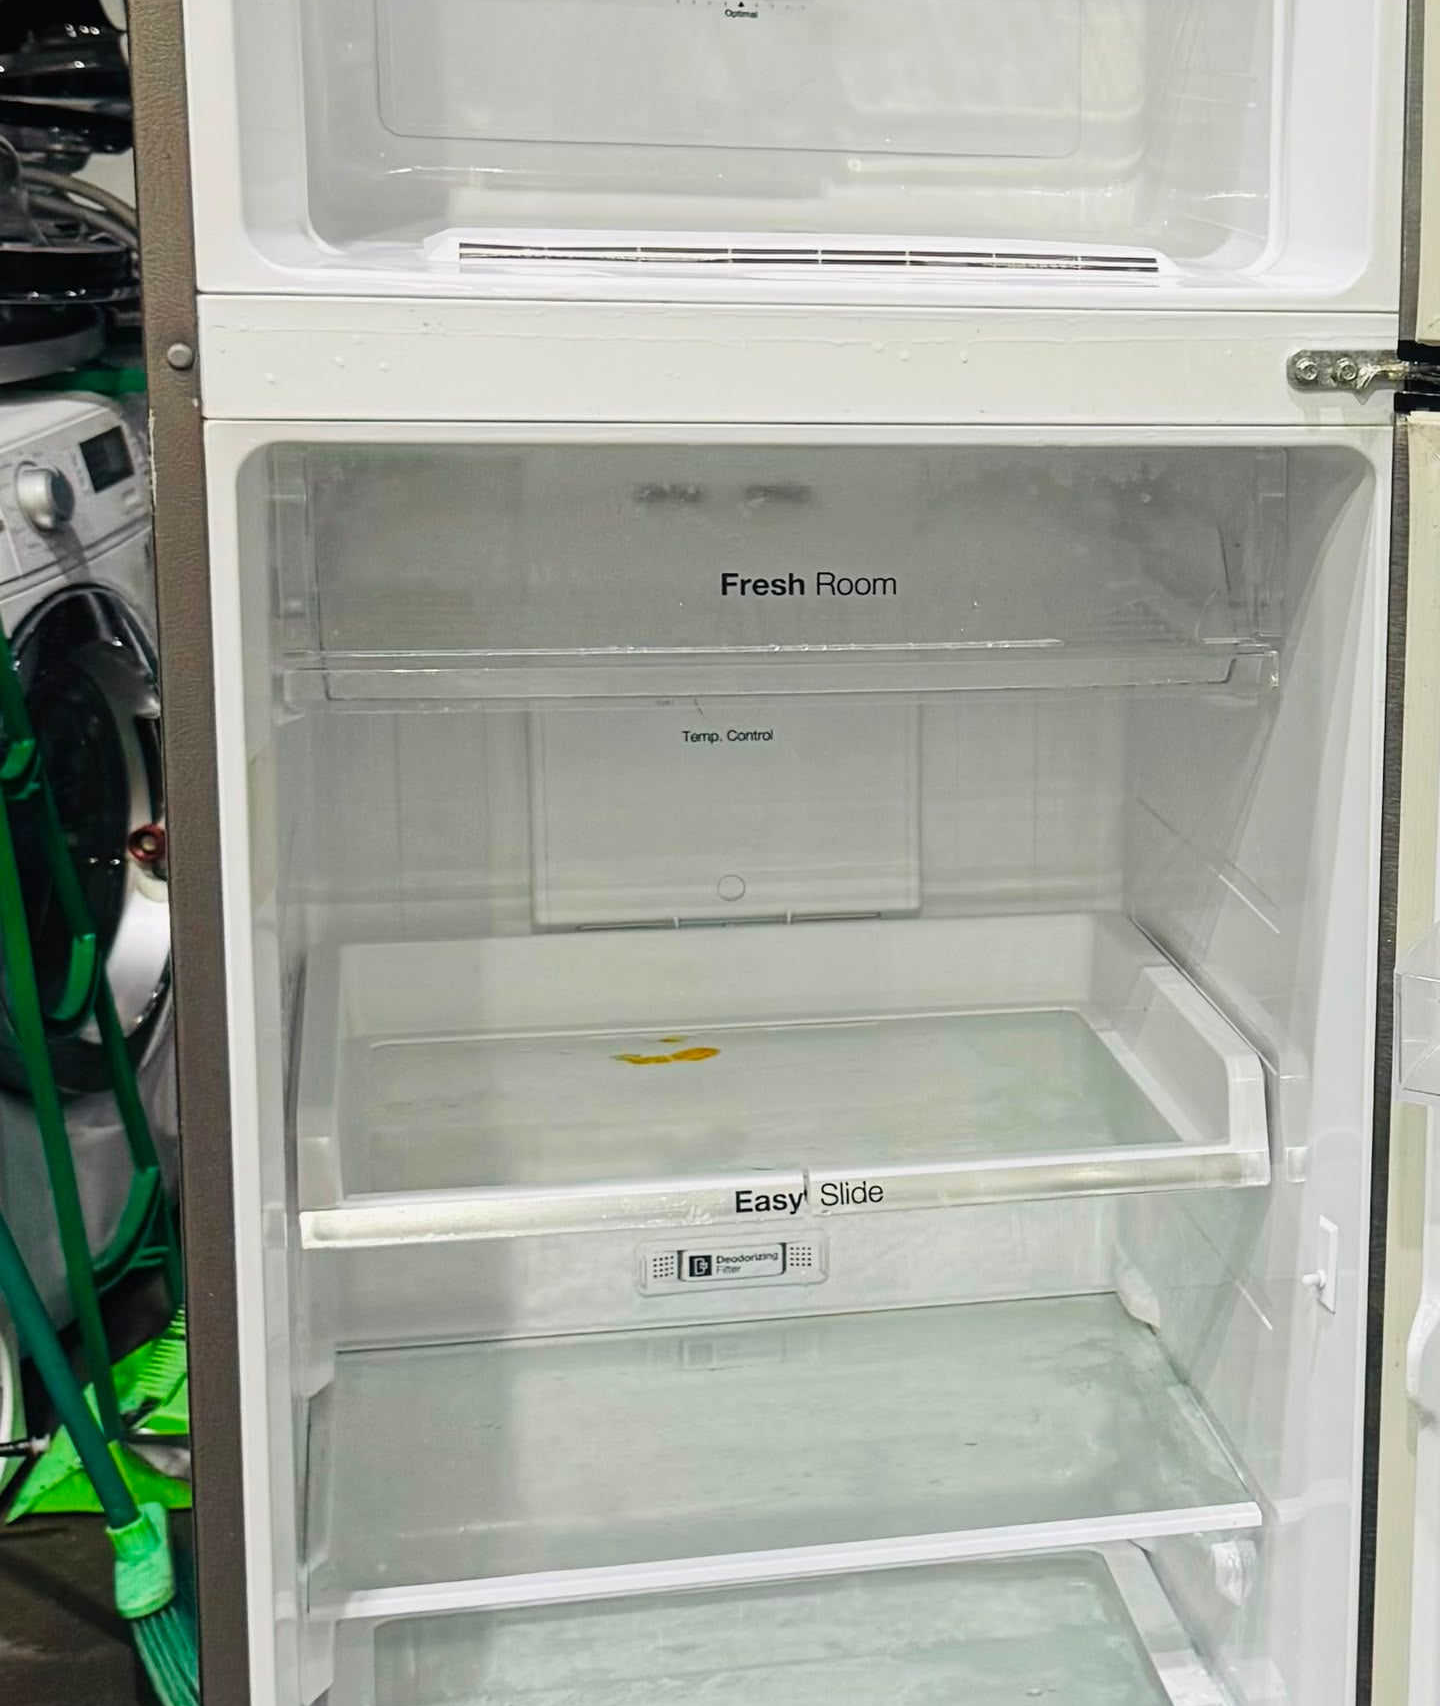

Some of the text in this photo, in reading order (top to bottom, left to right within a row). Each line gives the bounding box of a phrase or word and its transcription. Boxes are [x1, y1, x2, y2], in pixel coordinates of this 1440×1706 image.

[724, 9, 758, 19] Optimal
[720, 571, 897, 596] Fresh Room
[682, 729, 774, 744] Temp. Control
[735, 1180, 884, 1215] Easy Slide
[716, 1252, 779, 1264] Deodorizing
[716, 1264, 742, 1274] Filter
